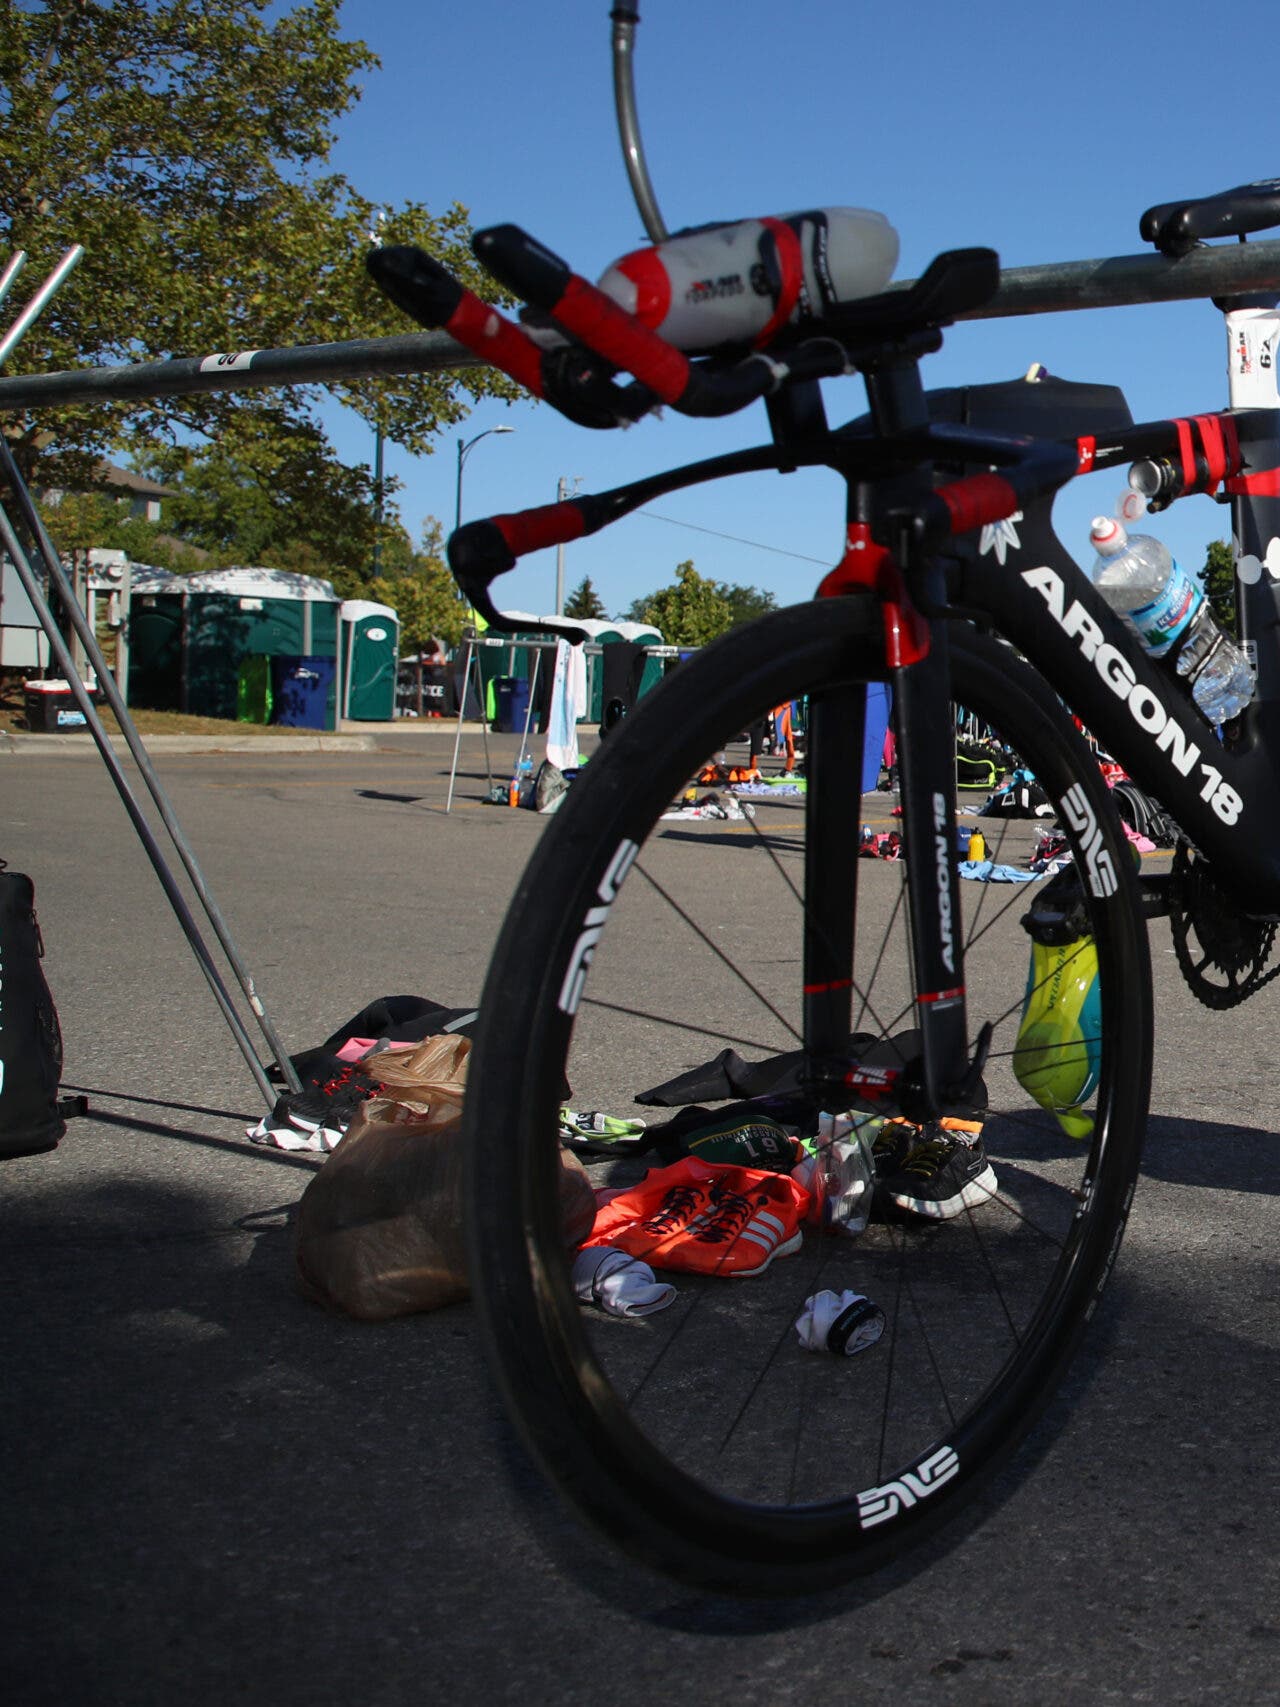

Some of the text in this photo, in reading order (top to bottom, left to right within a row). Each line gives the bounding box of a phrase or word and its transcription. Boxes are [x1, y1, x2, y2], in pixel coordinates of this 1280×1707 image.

[1021, 566, 1244, 826] ARGON 18
[935, 835, 954, 974] ARGON
